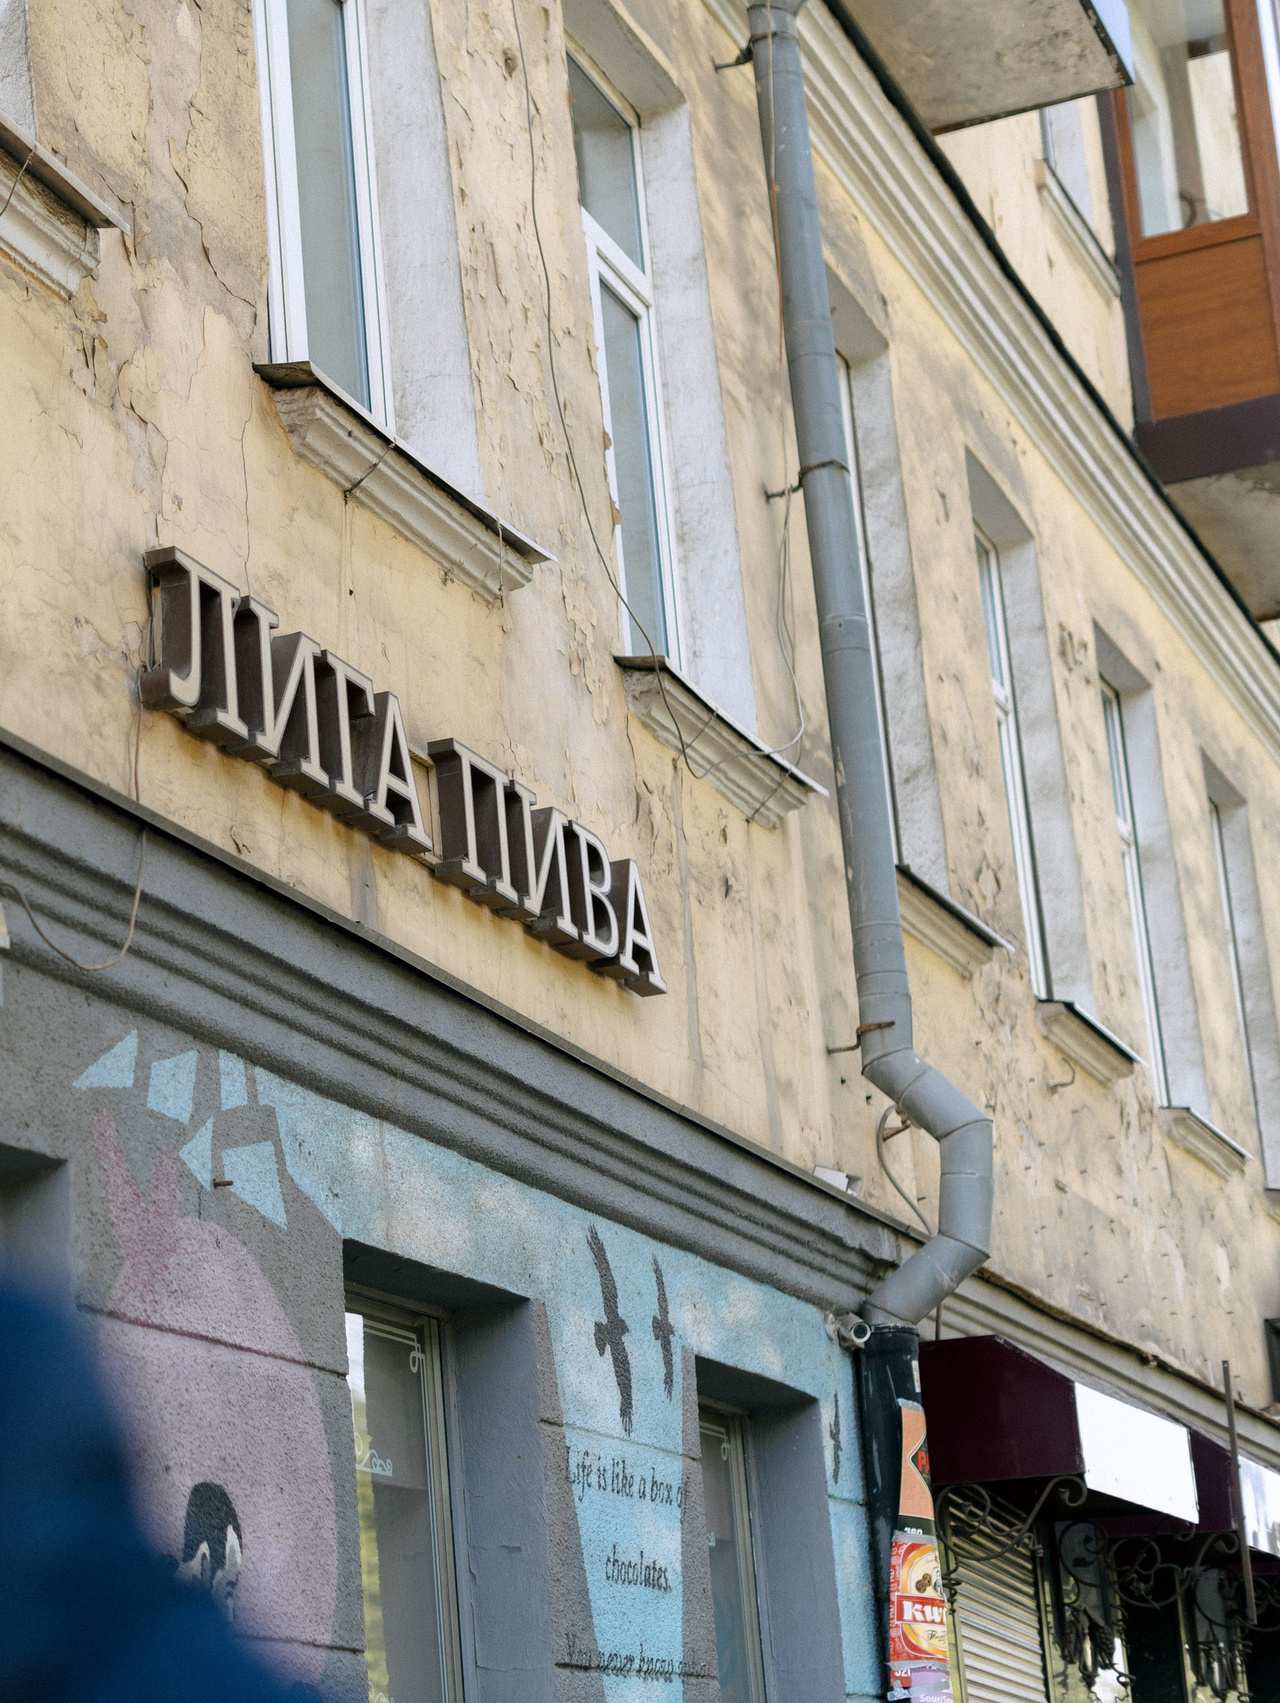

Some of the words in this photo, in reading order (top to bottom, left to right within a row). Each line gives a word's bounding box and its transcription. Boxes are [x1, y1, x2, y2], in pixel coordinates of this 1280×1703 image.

[160, 546, 432, 853] ЛИГА
[446, 738, 667, 994] ПИВА
[597, 1455, 607, 1491] is
[611, 1458, 634, 1498] like
[639, 1476, 646, 1500] a
[650, 1467, 673, 1506] box
